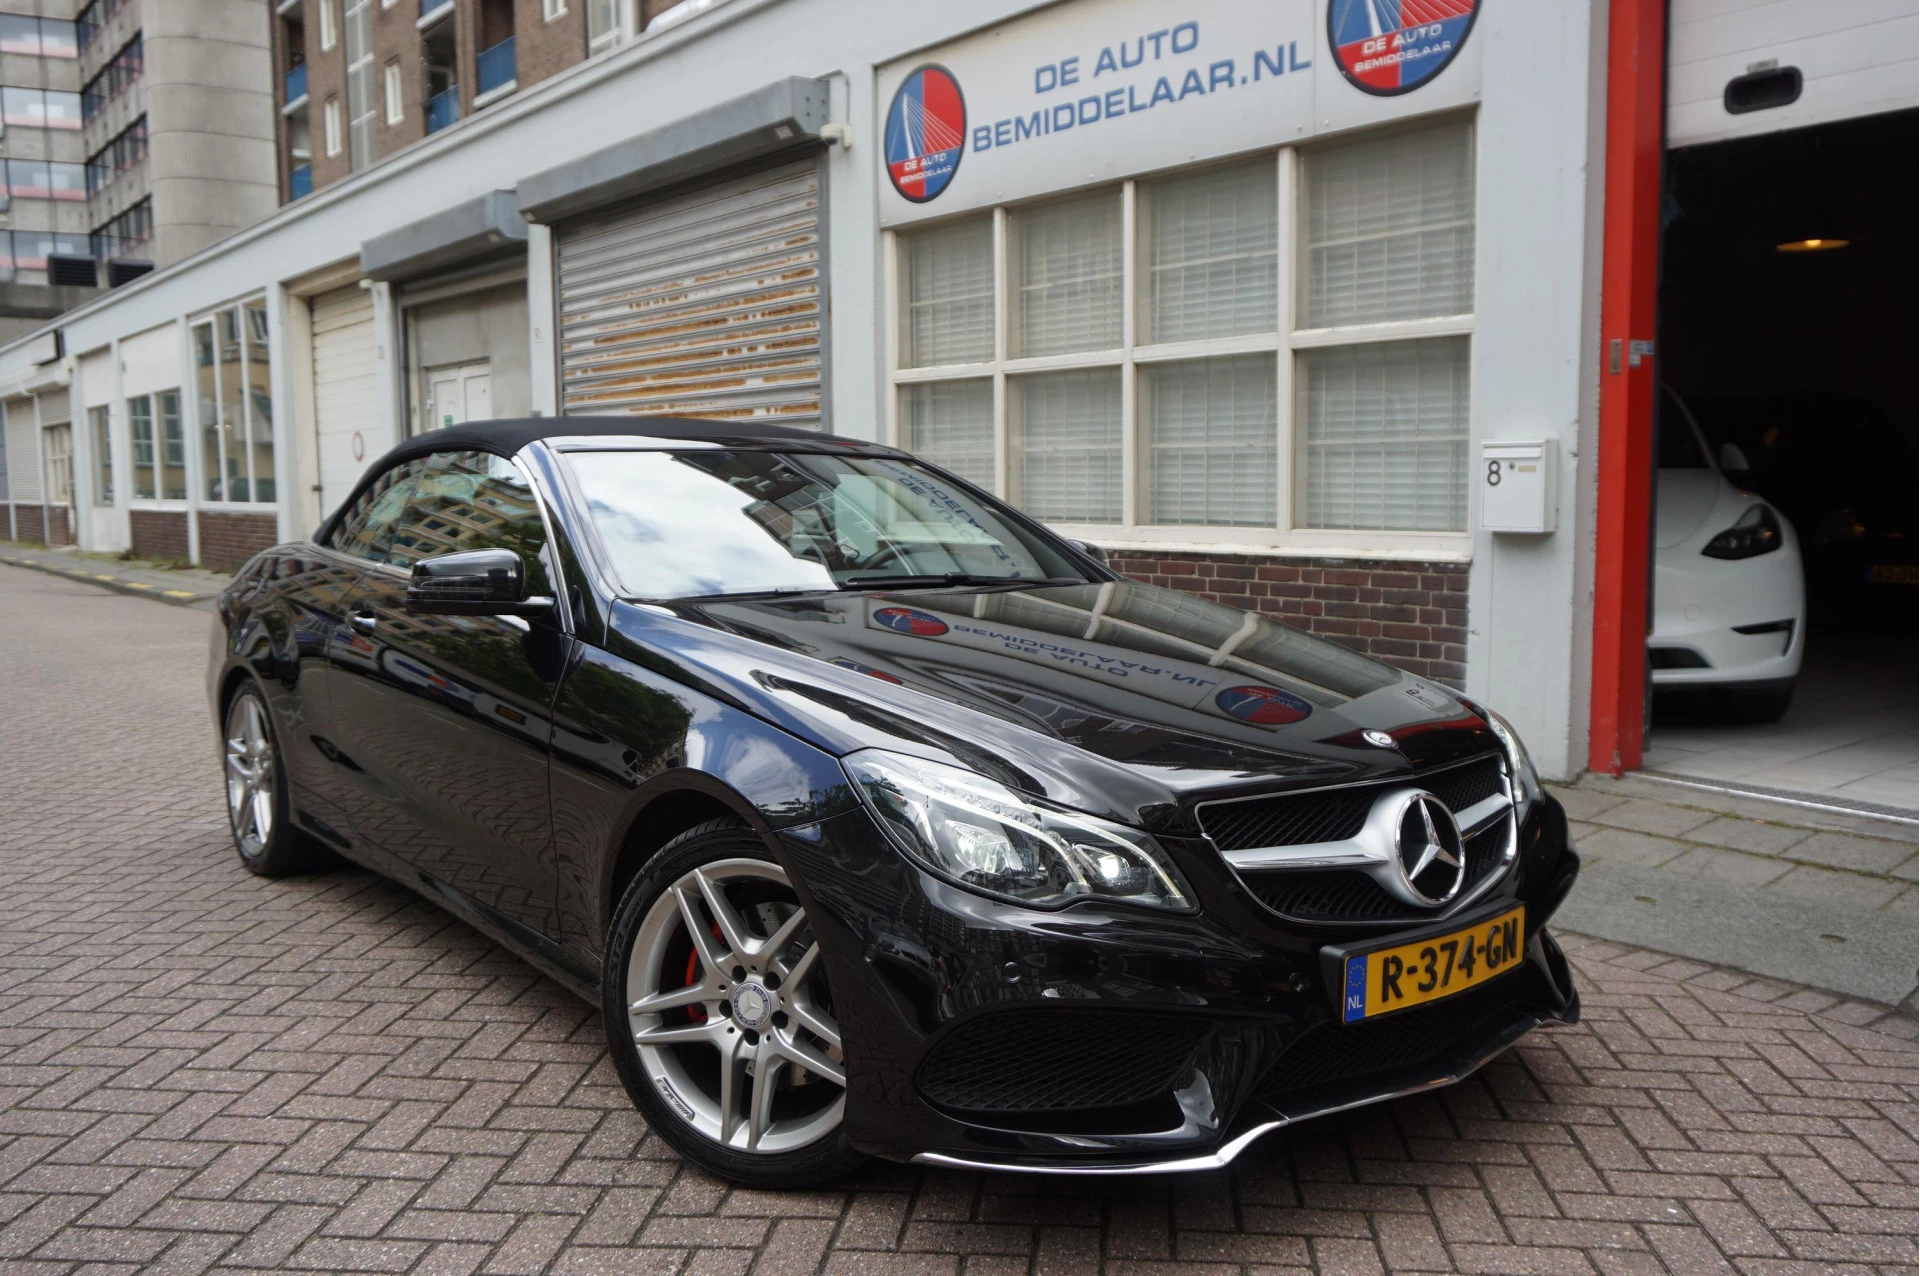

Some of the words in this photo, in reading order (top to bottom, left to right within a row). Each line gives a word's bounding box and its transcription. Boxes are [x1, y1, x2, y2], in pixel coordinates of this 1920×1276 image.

[1362, 37, 1388, 55] DE
[1392, 23, 1442, 46] AUTO
[1034, 55, 1080, 94] DE
[1093, 20, 1199, 78] AUTO
[1354, 41, 1452, 72] BEMIDDELAAR
[972, 40, 1312, 153] BEMIDDELAAR.NL
[904, 159, 918, 171] DE
[920, 153, 947, 166] AUTO
[1487, 460, 1501, 486] 8
[1381, 917, 1519, 1003] R-374-GN
[1348, 994, 1363, 1011] NL
